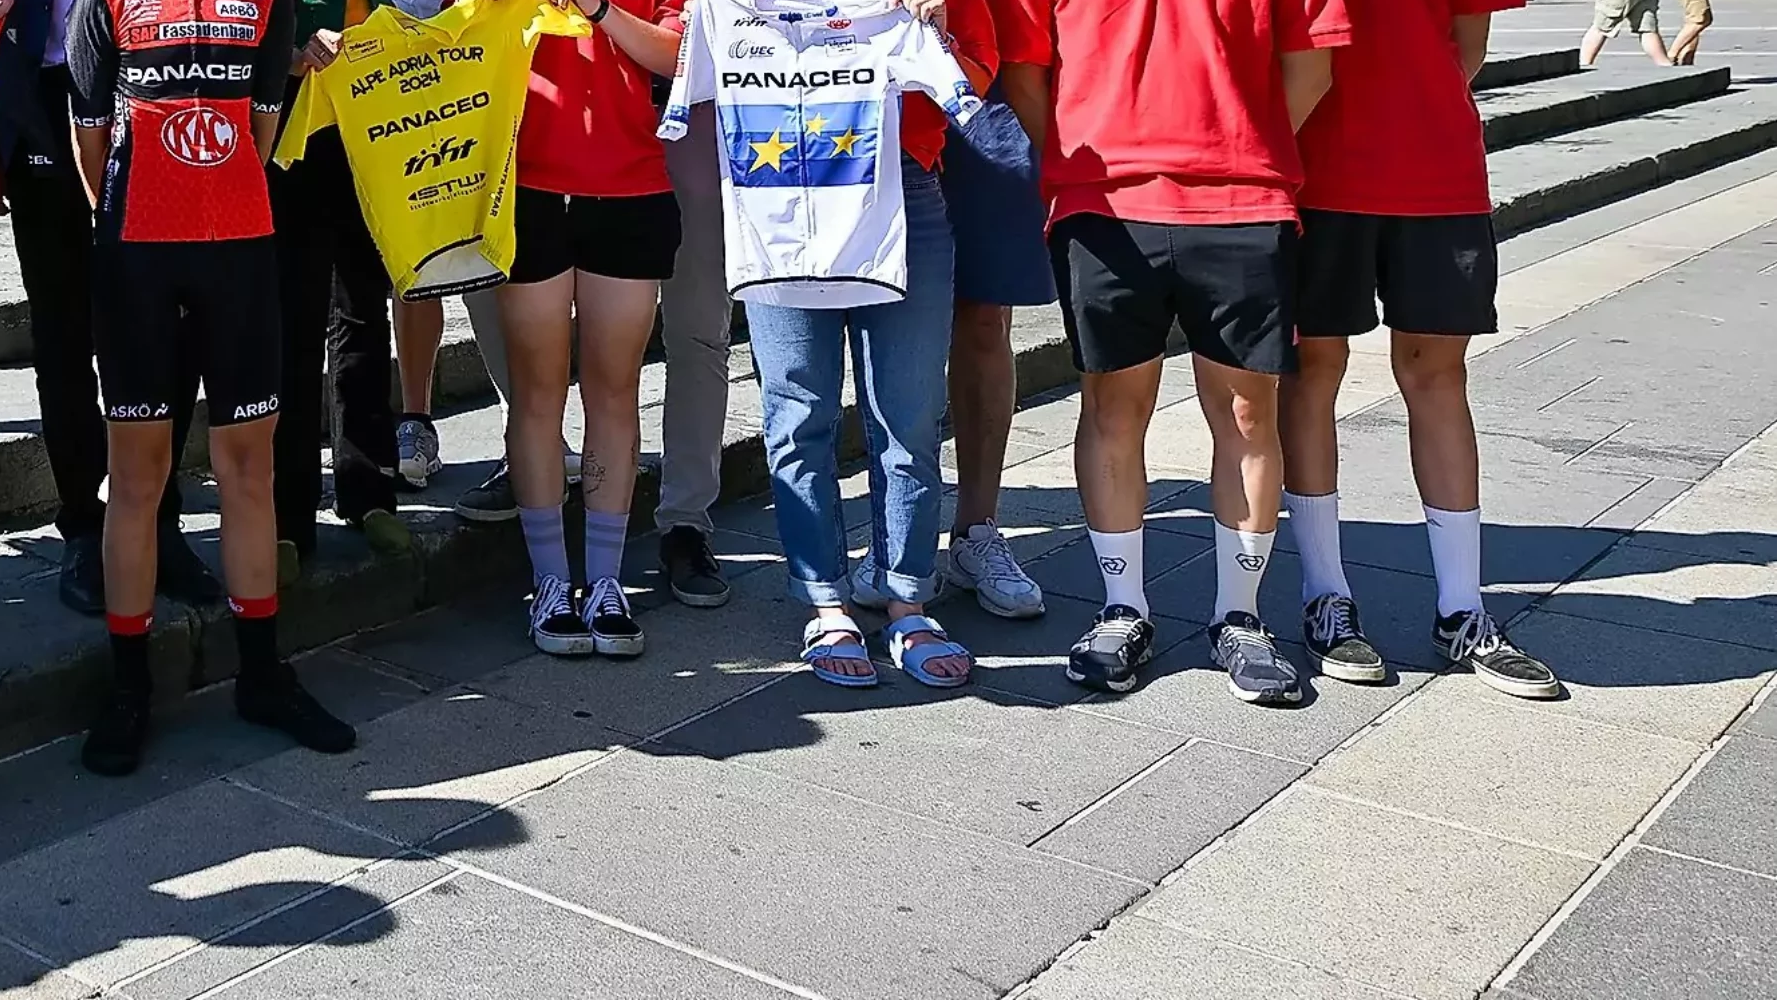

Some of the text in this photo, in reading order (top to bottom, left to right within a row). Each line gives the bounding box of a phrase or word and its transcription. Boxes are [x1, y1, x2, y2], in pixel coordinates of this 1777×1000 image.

[220, 3, 256, 18] ARBÖ
[130, 23, 255, 43] SAP Fassadenbau
[751, 45, 776, 55] UEC
[126, 63, 253, 84] PANACEO
[350, 46, 484, 99] ALPE ADRIA TOUR
[399, 68, 441, 94] 2024
[722, 68, 875, 89] PANACEO
[367, 91, 490, 143] PANACEO
[489, 186, 505, 218] WEAR
[110, 402, 151, 418] ASKÖ
[234, 394, 279, 420] ARBÖ
